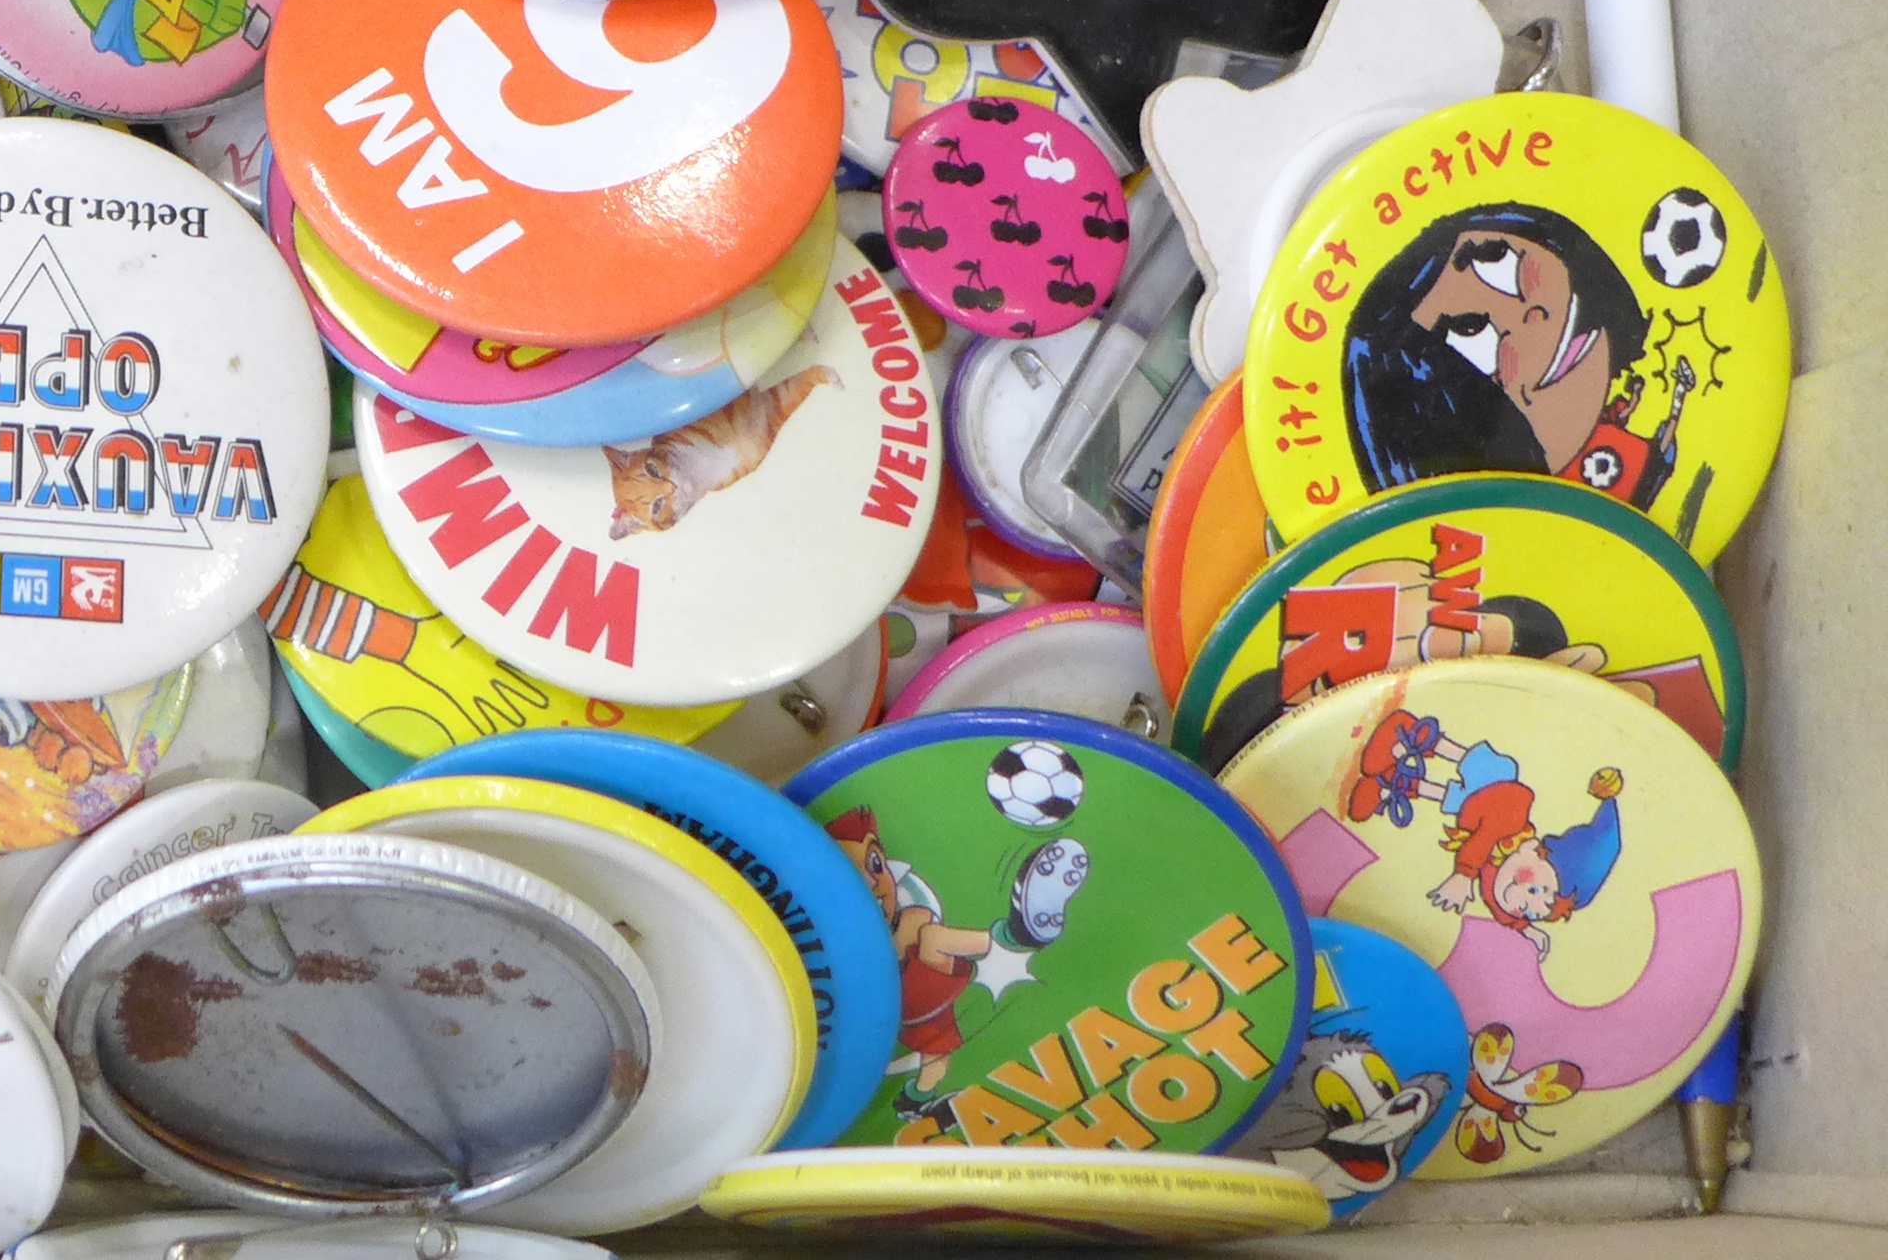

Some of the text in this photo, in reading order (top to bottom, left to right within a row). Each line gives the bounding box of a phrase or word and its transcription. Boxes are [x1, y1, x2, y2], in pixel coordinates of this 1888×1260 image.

[324, 67, 491, 209] AM
[21, 191, 75, 228] By
[85, 195, 210, 241] Better.
[1284, 237, 1359, 343] Get
[1372, 127, 1554, 227] active
[860, 266, 931, 529] WELCOME
[12, 566, 51, 606] GM
[1429, 522, 1485, 633] AW
